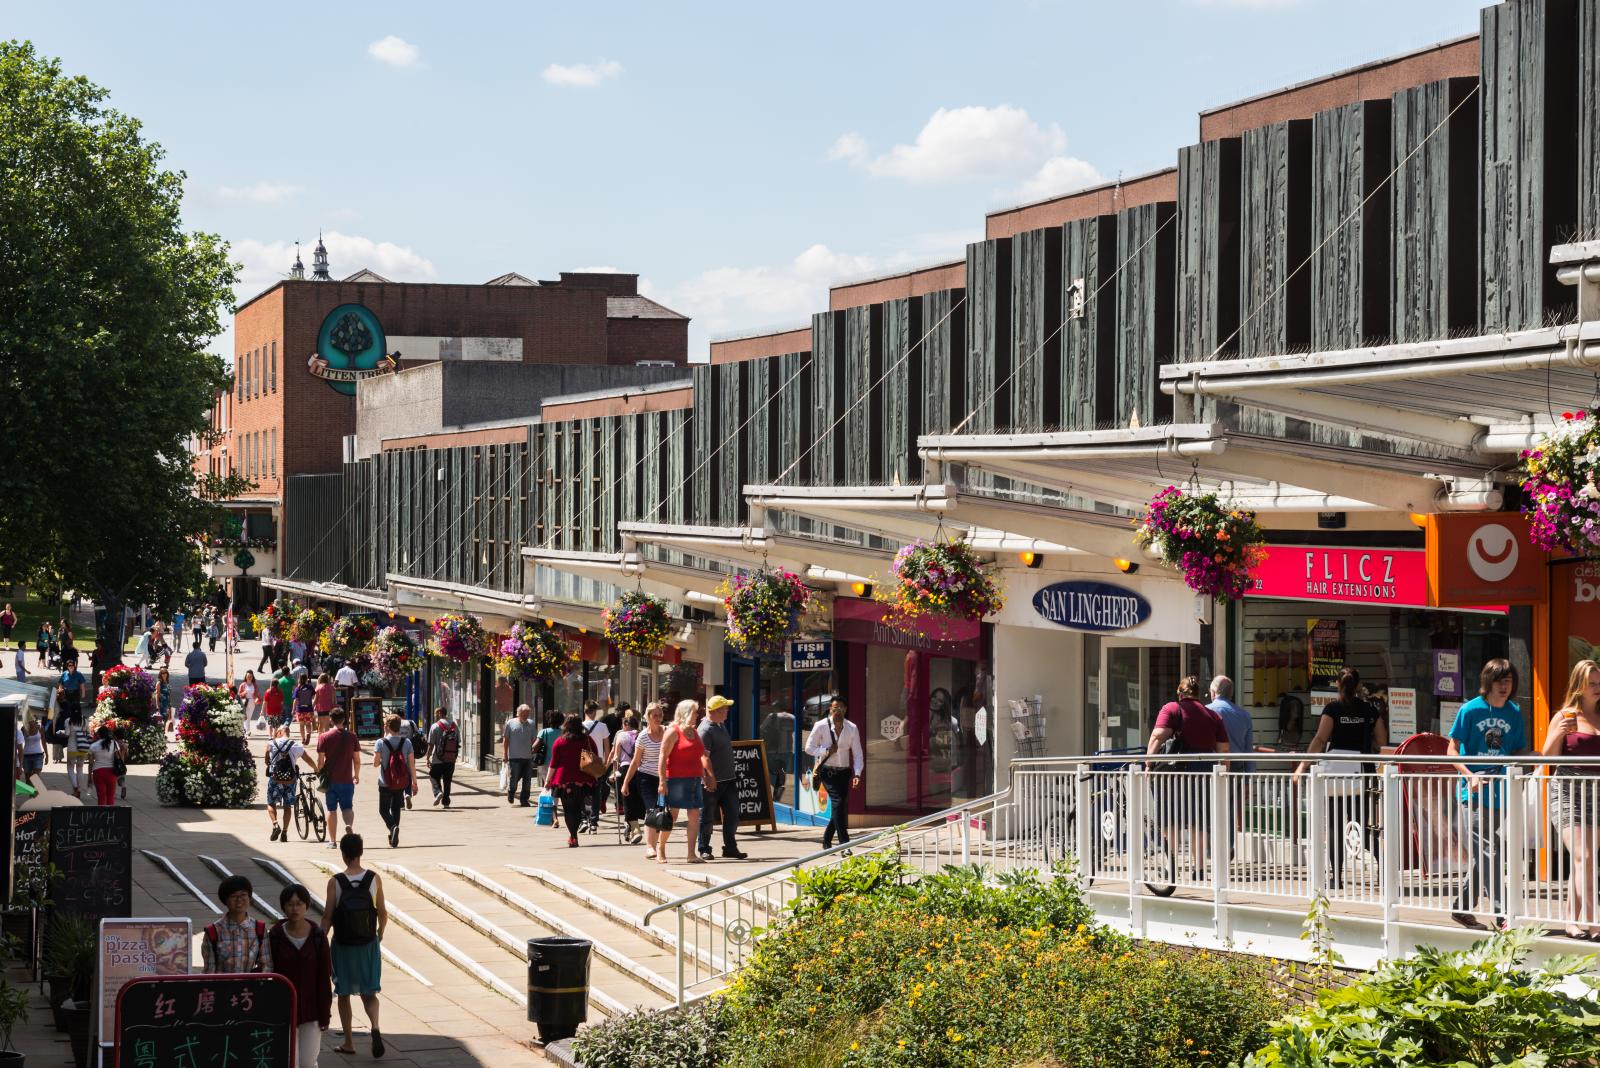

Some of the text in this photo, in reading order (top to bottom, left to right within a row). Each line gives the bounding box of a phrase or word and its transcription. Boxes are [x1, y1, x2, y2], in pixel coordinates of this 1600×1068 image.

[1305, 552, 1395, 583] FLICZ
[1306, 581, 1396, 598] HAIR EXTENSIONS
[1042, 589, 1139, 628] SAN LINGHERB
[873, 620, 890, 643] Ann
[797, 643, 825, 652] FISH
[806, 652, 816, 660] &
[792, 659, 830, 668] CHIPS
[1476, 717, 1512, 734] PUGS
[739, 789, 759, 799] NOW
[739, 801, 762, 814] PEN
[16, 831, 37, 840] HOT
[106, 940, 148, 954] pizza
[111, 951, 157, 967] pasta
